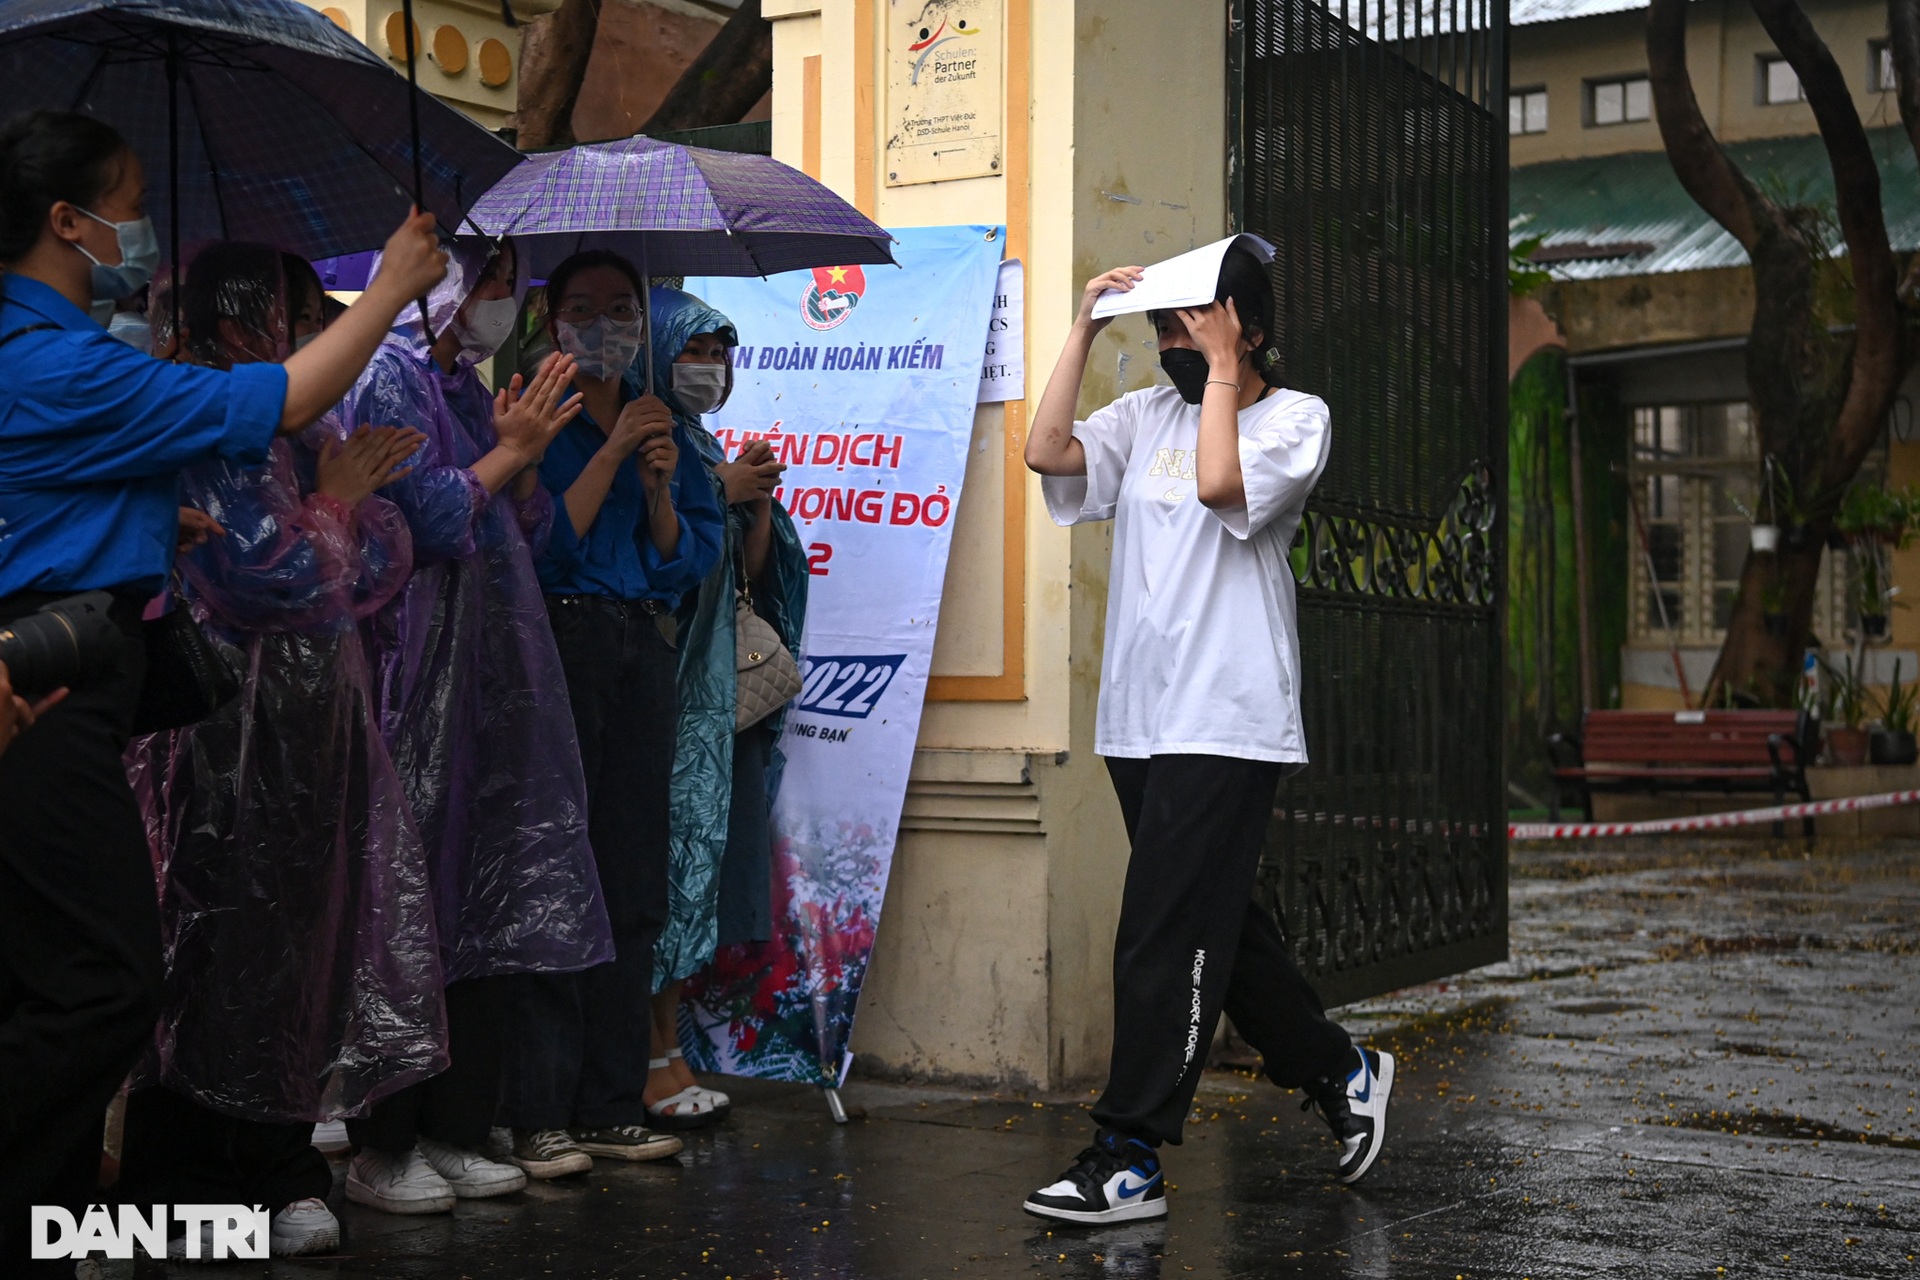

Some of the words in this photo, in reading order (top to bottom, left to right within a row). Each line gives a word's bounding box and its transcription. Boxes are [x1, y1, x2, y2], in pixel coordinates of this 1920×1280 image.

[934, 47, 977, 60] Schulen:
[935, 59, 977, 73] Partner
[934, 74, 947, 83] der
[947, 70, 976, 82] Zukunft
[757, 341, 818, 370] ĐOÀN
[821, 341, 884, 370] HOÀN
[886, 337, 945, 370] KIẾM
[981, 363, 1011, 381] IỆT.
[811, 433, 903, 471] DỊCH
[889, 485, 950, 527] ĐỎ
[800, 660, 893, 713] 022
[819, 727, 848, 744] BẠN
[1191, 949, 1206, 987] MORE
[1184, 1025, 1199, 1064] MORE
